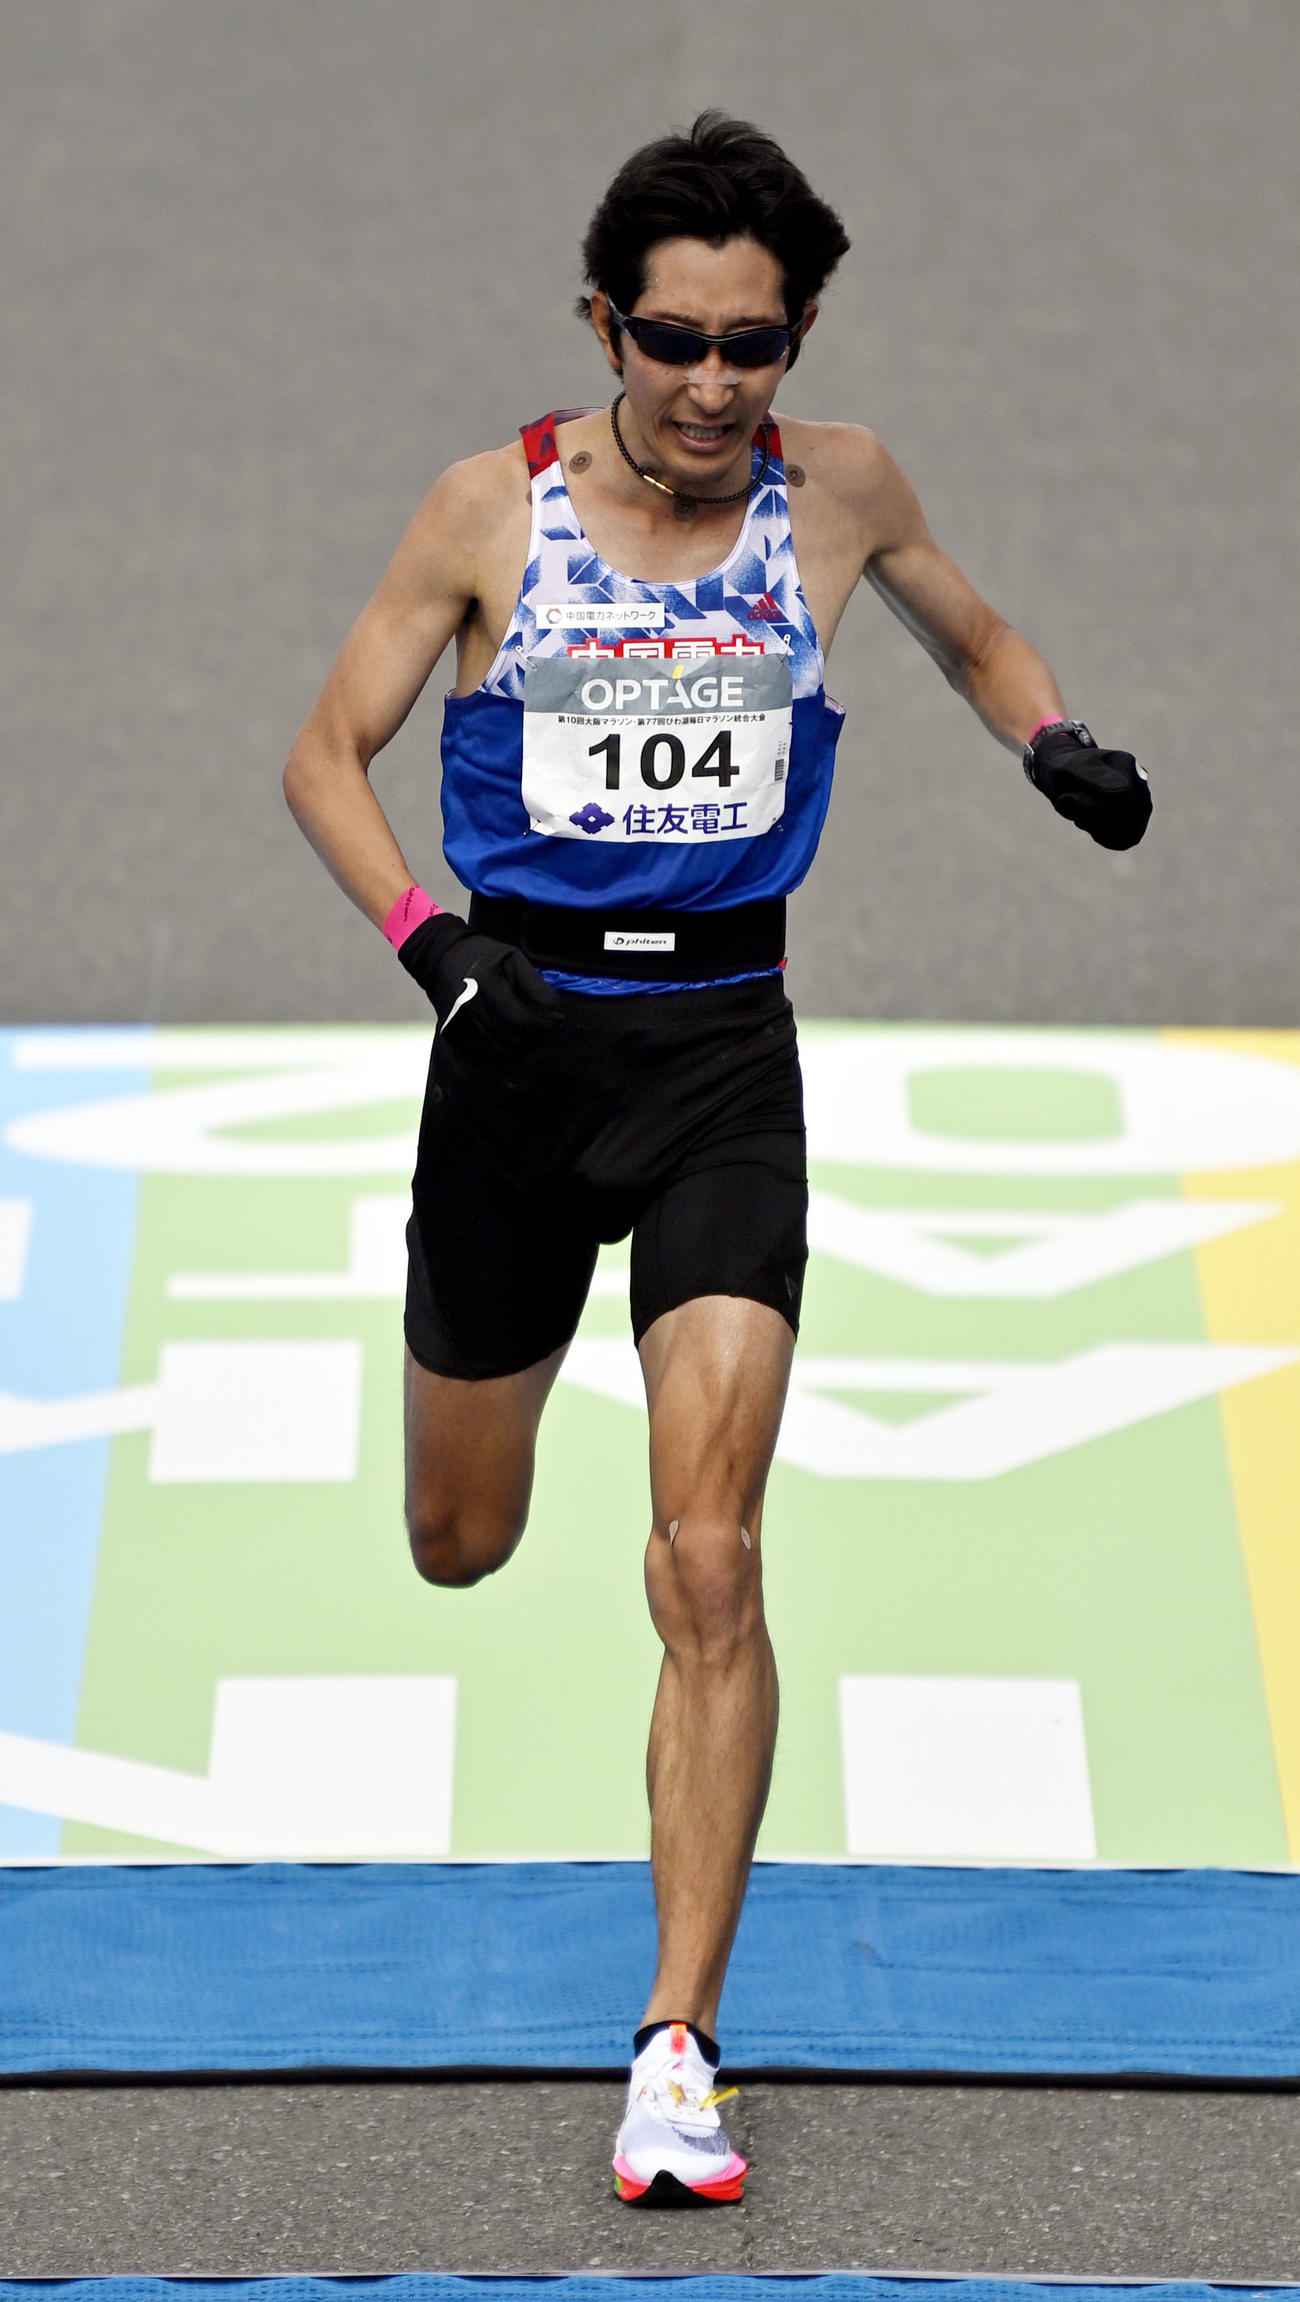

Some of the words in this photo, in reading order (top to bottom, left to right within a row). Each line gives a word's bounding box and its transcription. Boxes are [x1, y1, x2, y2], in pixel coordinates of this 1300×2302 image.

[566, 610, 656, 622] 中国電力ネットワーク
[581, 664, 744, 710] OPTAGE
[588, 730, 740, 790] 104
[622, 801, 748, 835] 住友電工
